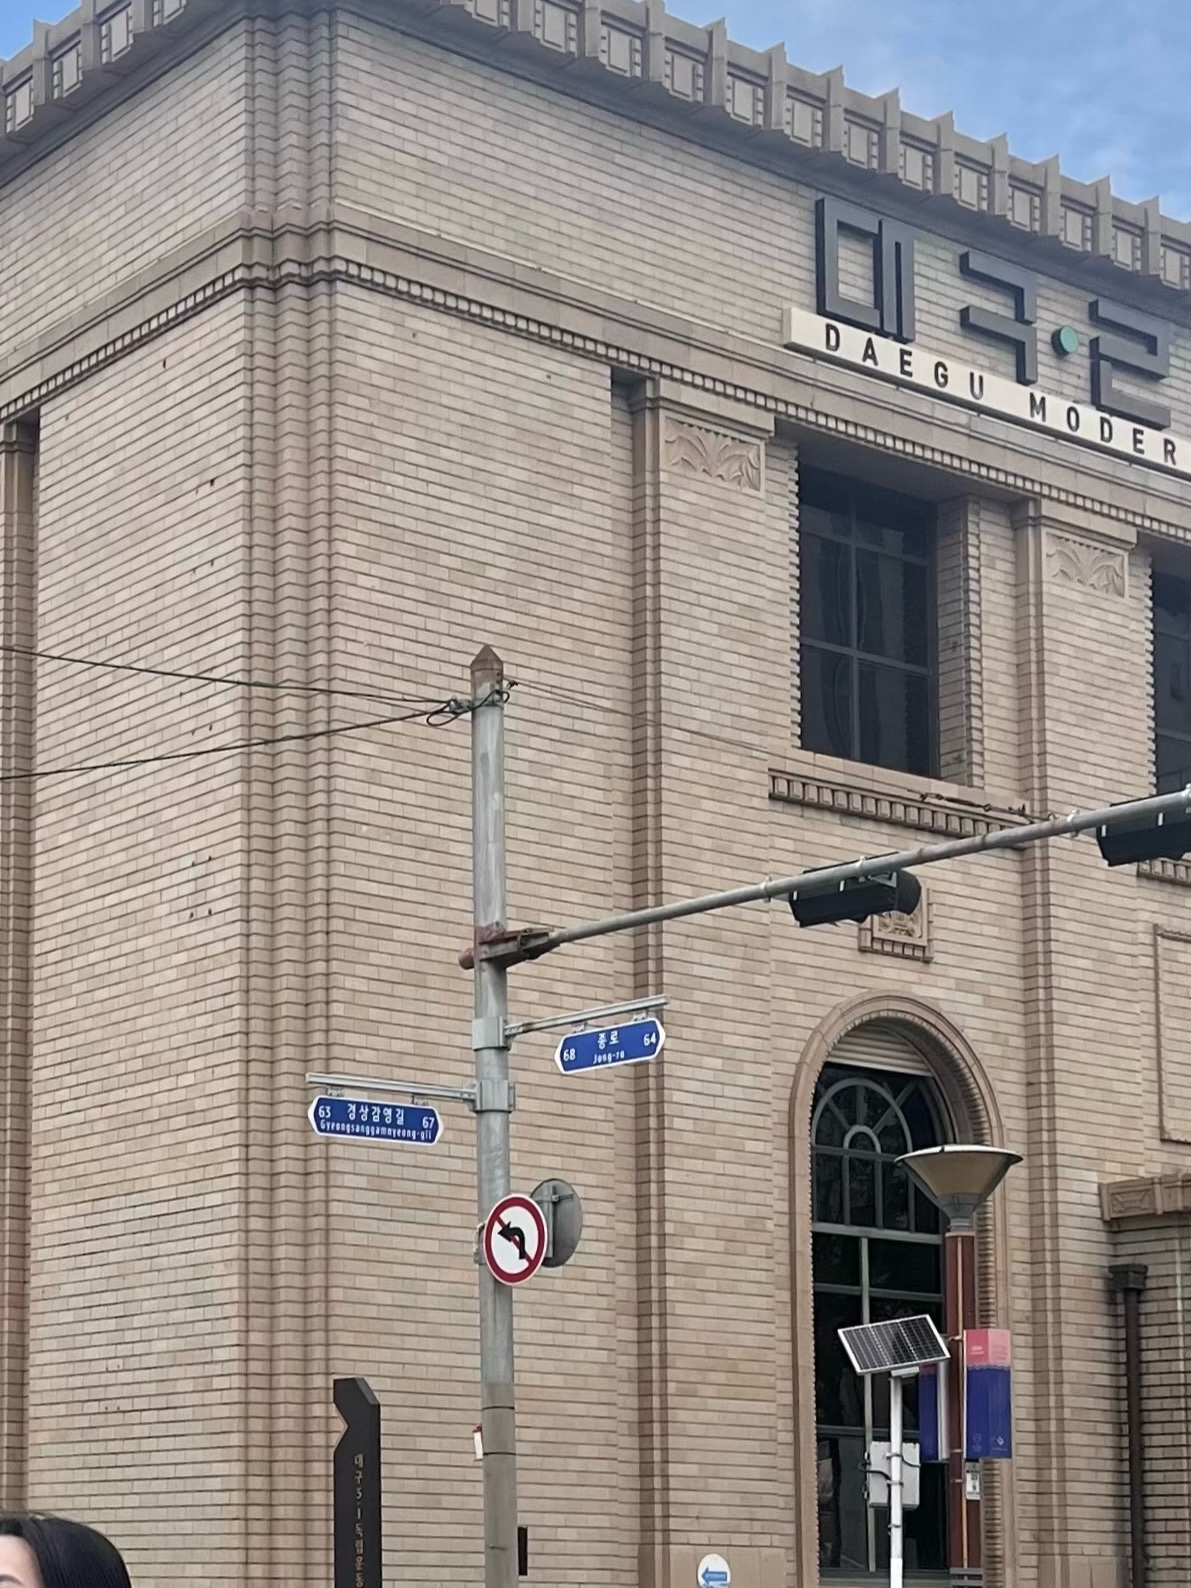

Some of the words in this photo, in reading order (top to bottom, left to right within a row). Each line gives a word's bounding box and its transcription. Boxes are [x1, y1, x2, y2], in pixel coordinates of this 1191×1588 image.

[825, 323, 984, 400] DAEGU
[1029, 392, 1177, 466] MODER
[563, 1048, 576, 1061] 68
[597, 1030, 619, 1049] 종로
[643, 1032, 656, 1046] 64
[318, 1105, 331, 1118] 63
[347, 1103, 404, 1126] 경상감영길
[422, 1116, 434, 1129] 67
